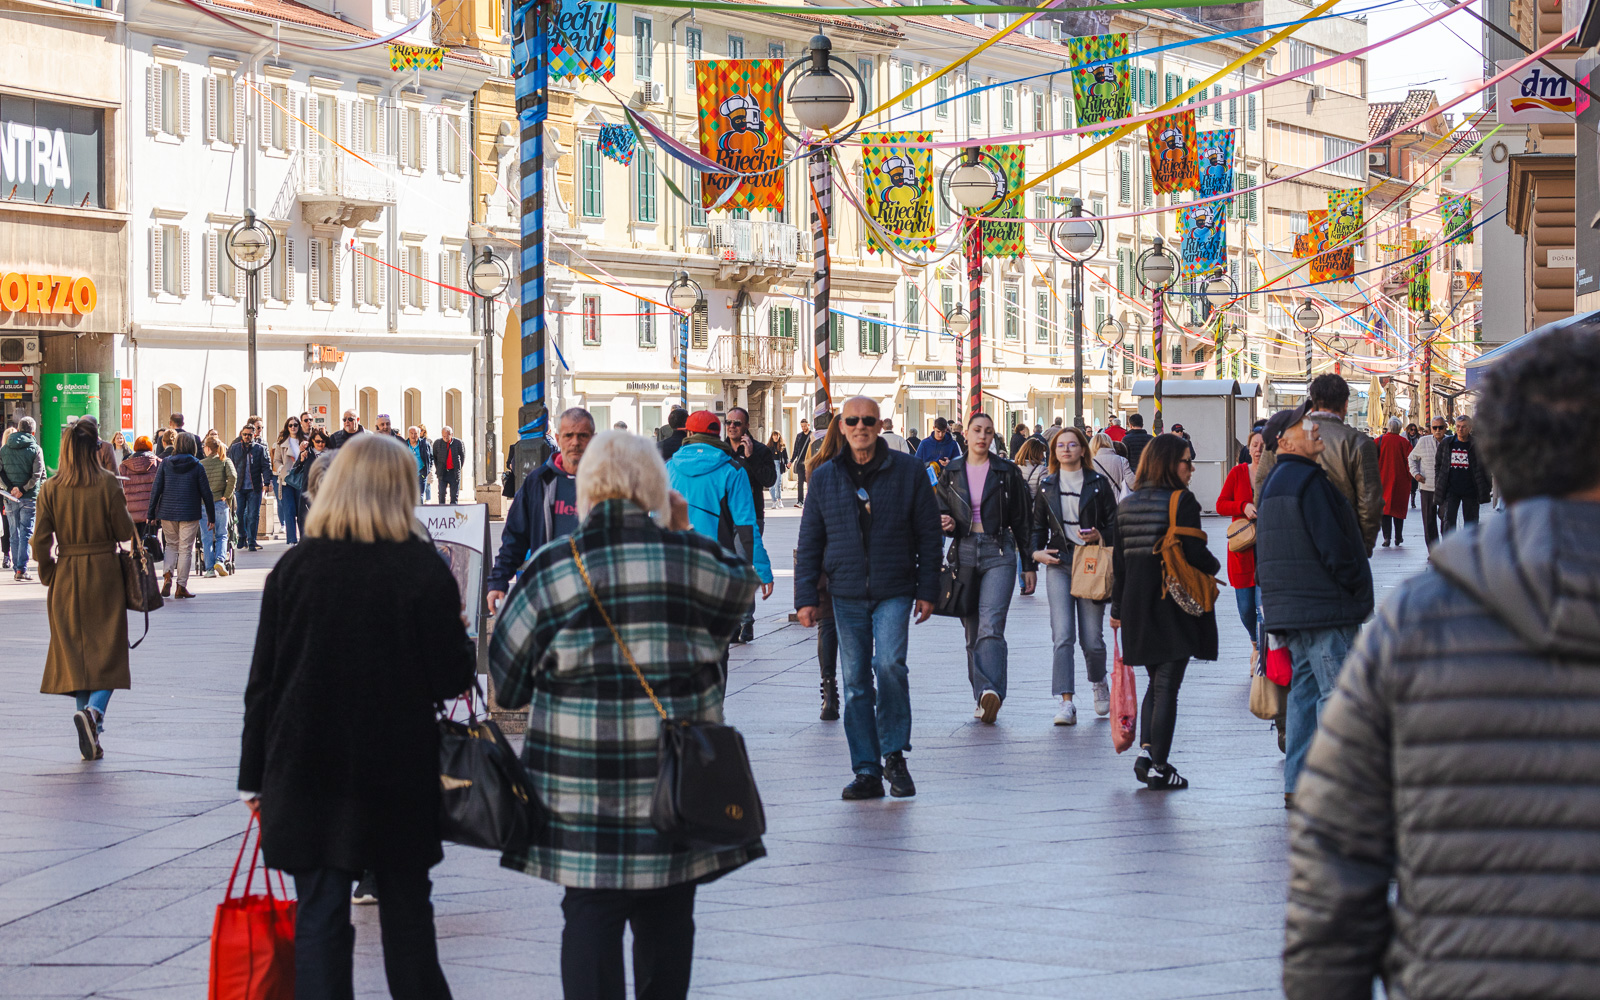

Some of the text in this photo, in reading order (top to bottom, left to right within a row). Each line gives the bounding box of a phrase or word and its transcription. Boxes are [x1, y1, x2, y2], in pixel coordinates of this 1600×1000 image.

[1520, 68, 1568, 98] dm
[0, 271, 98, 315] ORZO
[427, 516, 457, 530] MAR
